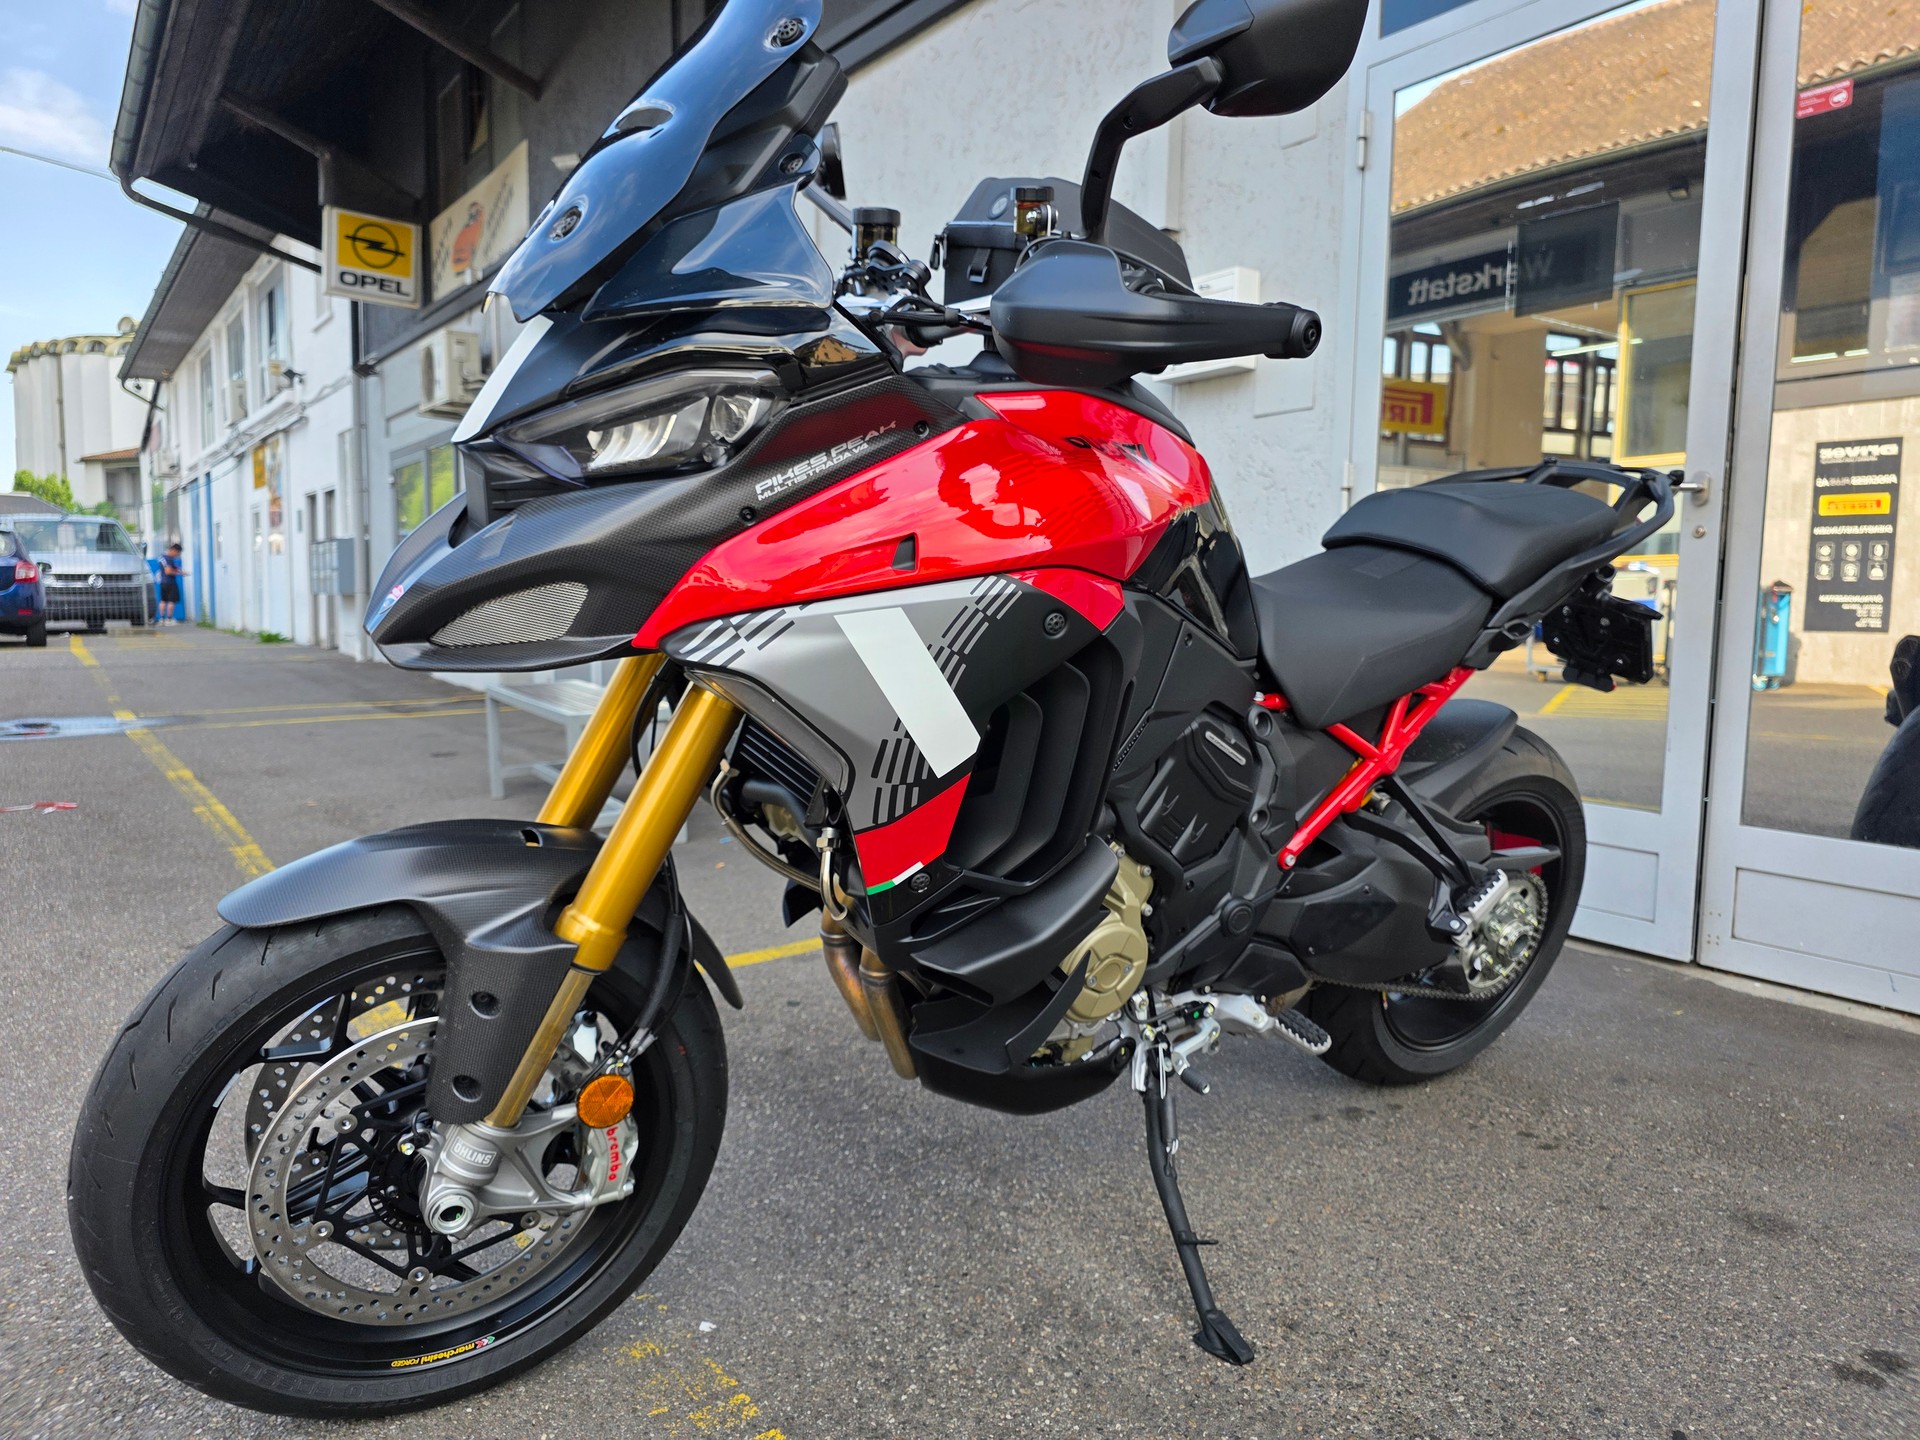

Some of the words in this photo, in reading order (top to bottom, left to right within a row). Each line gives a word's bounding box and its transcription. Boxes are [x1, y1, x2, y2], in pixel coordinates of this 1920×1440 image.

[339, 271, 410, 297] OPEL
[755, 451, 827, 495] PIKES
[830, 420, 897, 459] PEAK
[757, 451, 853, 501] MULTISTRADA
[853, 443, 870, 456] V4
[453, 1138, 493, 1165] ÖHLINS
[606, 1125, 623, 1182] brembo
[390, 1358, 419, 1368] FORGED
[421, 1343, 475, 1364] marchesini
